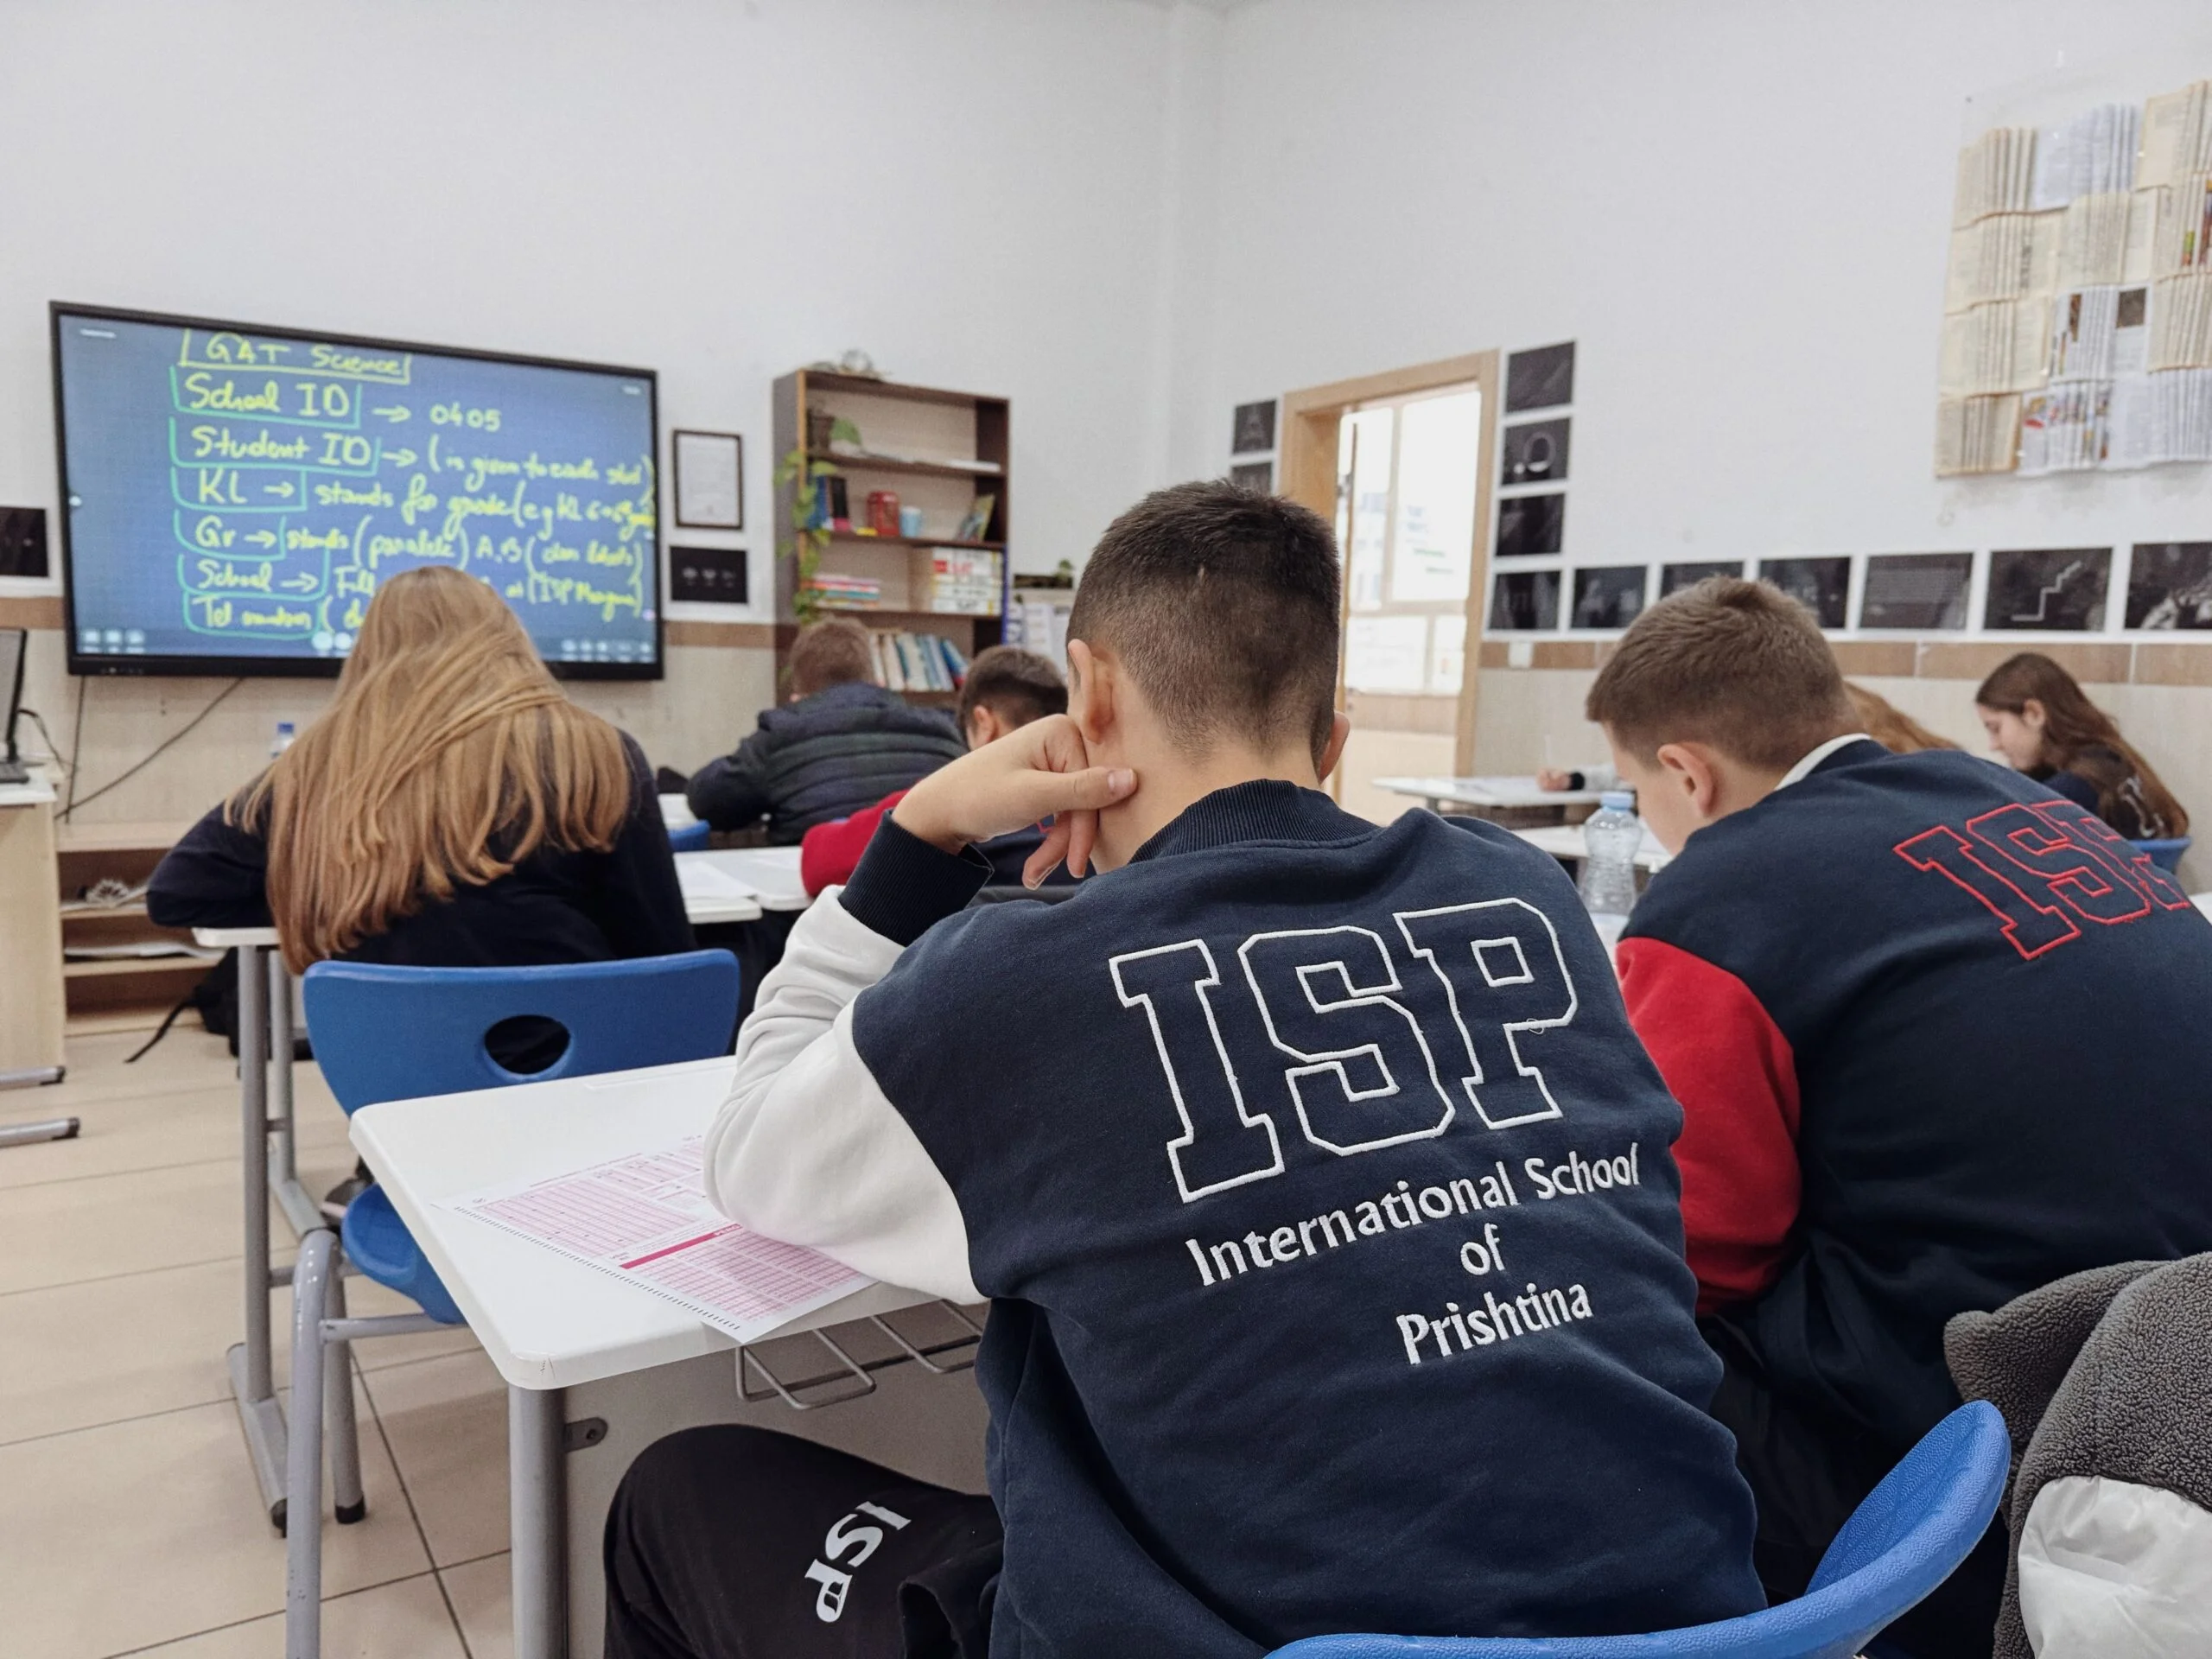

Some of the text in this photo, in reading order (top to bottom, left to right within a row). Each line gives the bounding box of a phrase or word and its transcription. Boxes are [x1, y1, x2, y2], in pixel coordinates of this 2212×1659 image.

[184, 372, 281, 413] School
[429, 402, 502, 432] 0405
[191, 425, 311, 458] Student
[200, 467, 247, 505] KL
[1892, 799, 2191, 961] ISP
[1108, 897, 1579, 1204] ISP
[1185, 1142, 1640, 1287] International School
[1459, 1223, 1505, 1276] of
[1395, 1283, 1593, 1365] Prishtina
[804, 1500, 912, 1624] ISP
